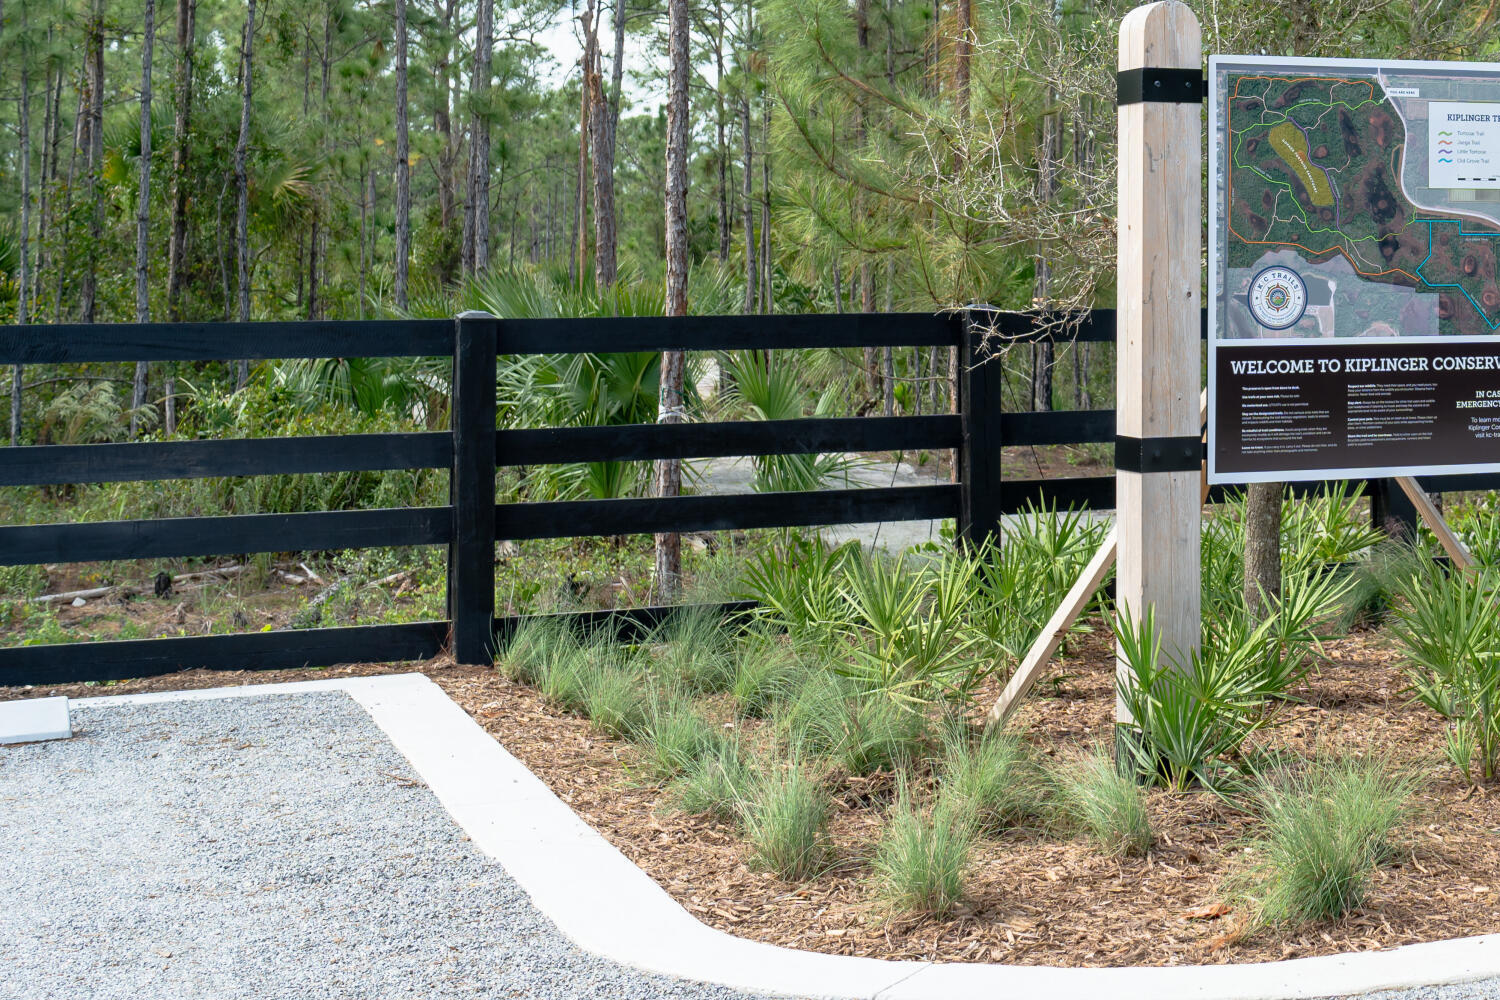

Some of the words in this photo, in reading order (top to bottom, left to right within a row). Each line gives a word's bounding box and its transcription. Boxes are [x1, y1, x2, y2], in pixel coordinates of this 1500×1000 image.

[1447, 114, 1490, 122] KIPLINGER
[1272, 273, 1299, 289] TRAILS
[1230, 360, 1314, 374] WELCOME
[1318, 359, 1341, 373] TO
[1345, 357, 1429, 372] KIPLINGER
